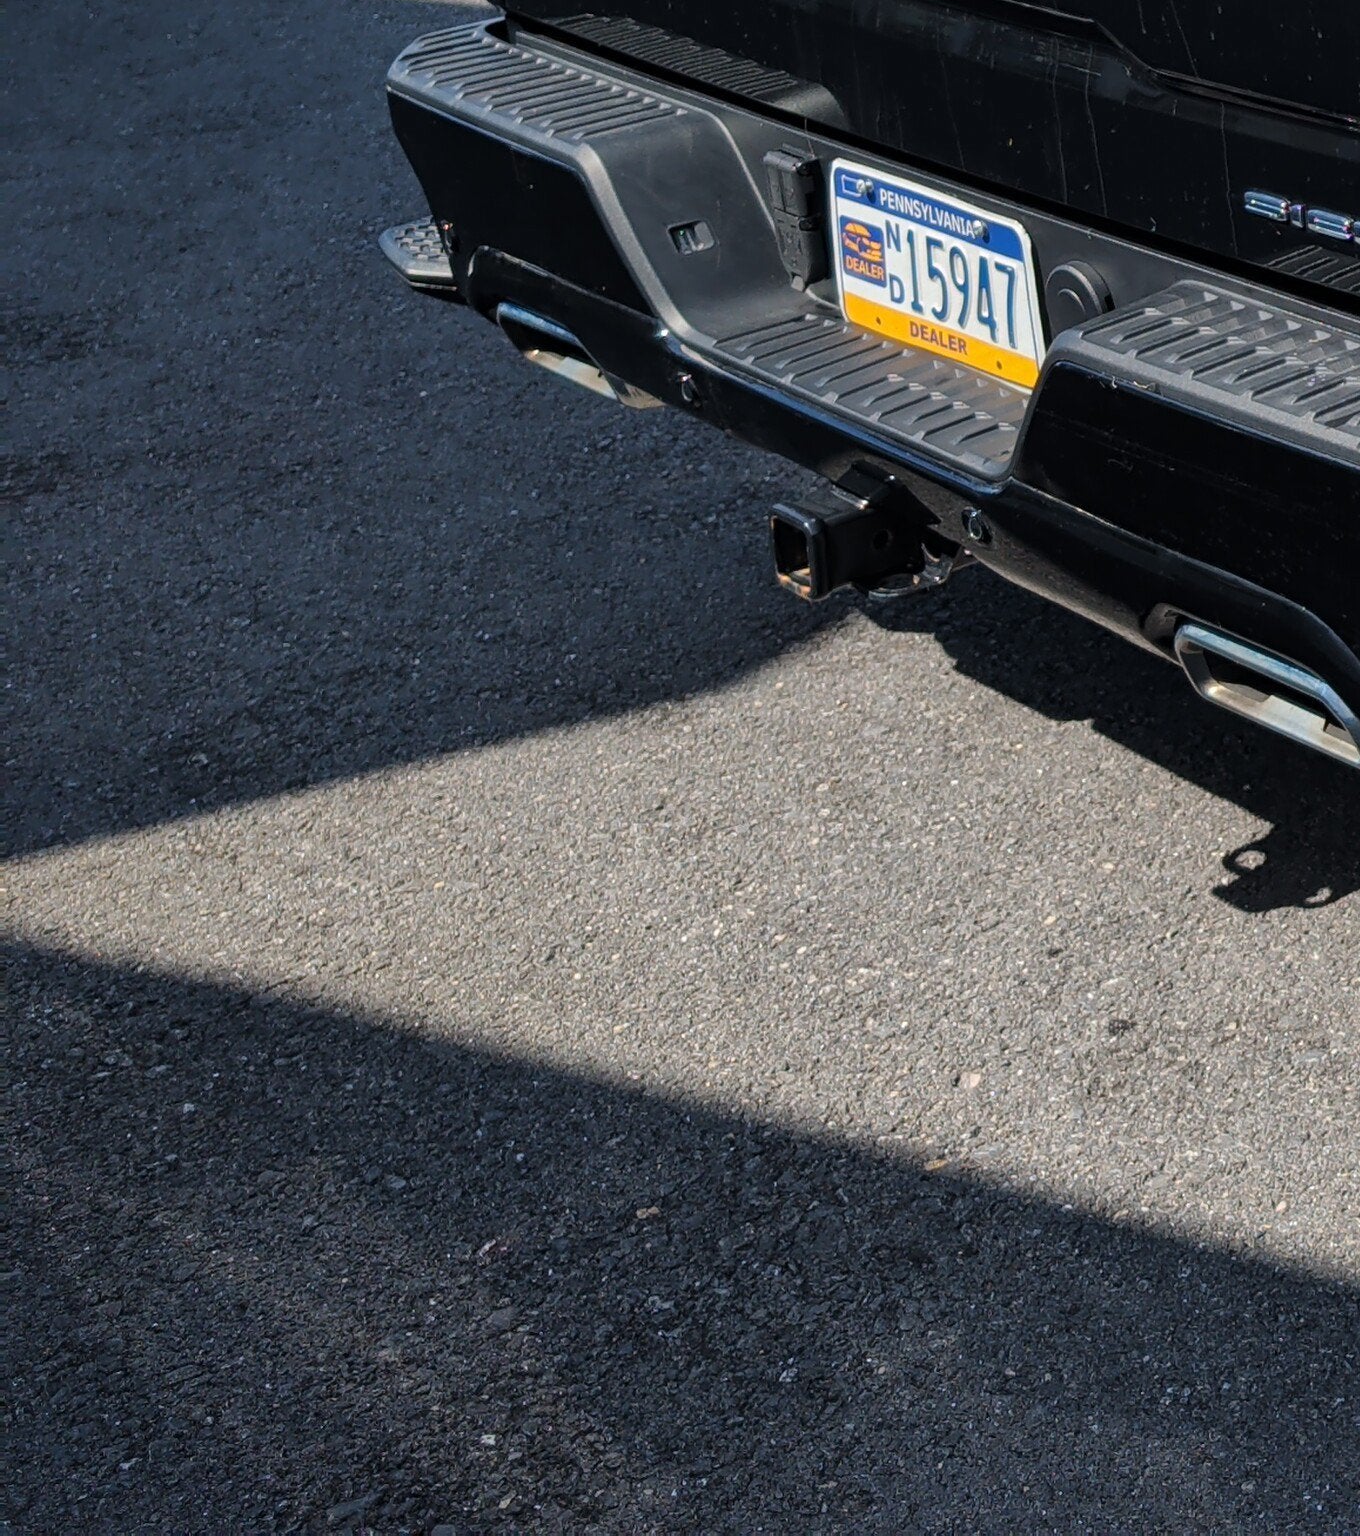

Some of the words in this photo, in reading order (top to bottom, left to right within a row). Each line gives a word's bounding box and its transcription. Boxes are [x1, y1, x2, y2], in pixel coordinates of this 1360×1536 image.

[879, 187, 976, 240] PENNSYLVANIA
[845, 256, 885, 282] DEALER
[907, 228, 1019, 349] 15947
[909, 320, 968, 356] DEALER
